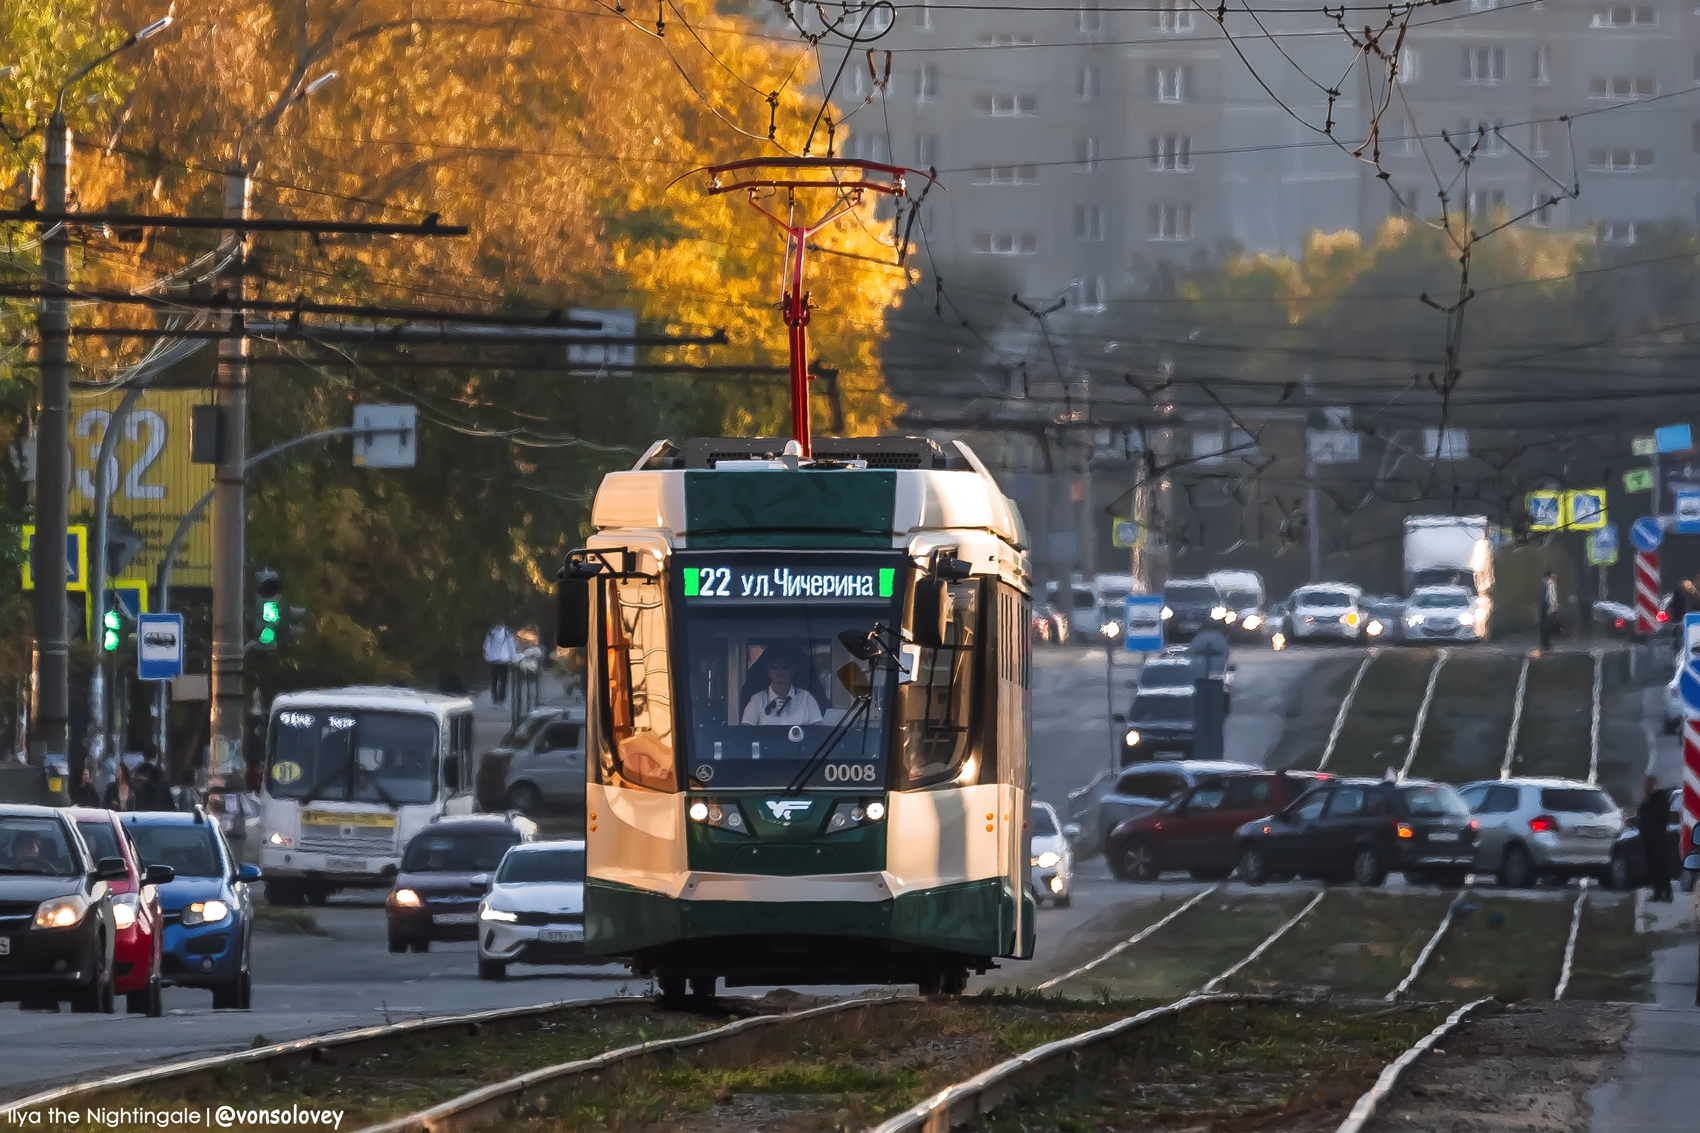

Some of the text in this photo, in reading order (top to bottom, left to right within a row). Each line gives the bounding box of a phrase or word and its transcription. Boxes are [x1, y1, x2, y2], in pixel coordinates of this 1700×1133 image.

[66, 408, 165, 499] 32
[700, 567, 874, 597] 22 ул.Чичерина
[824, 764, 876, 782] 0008
